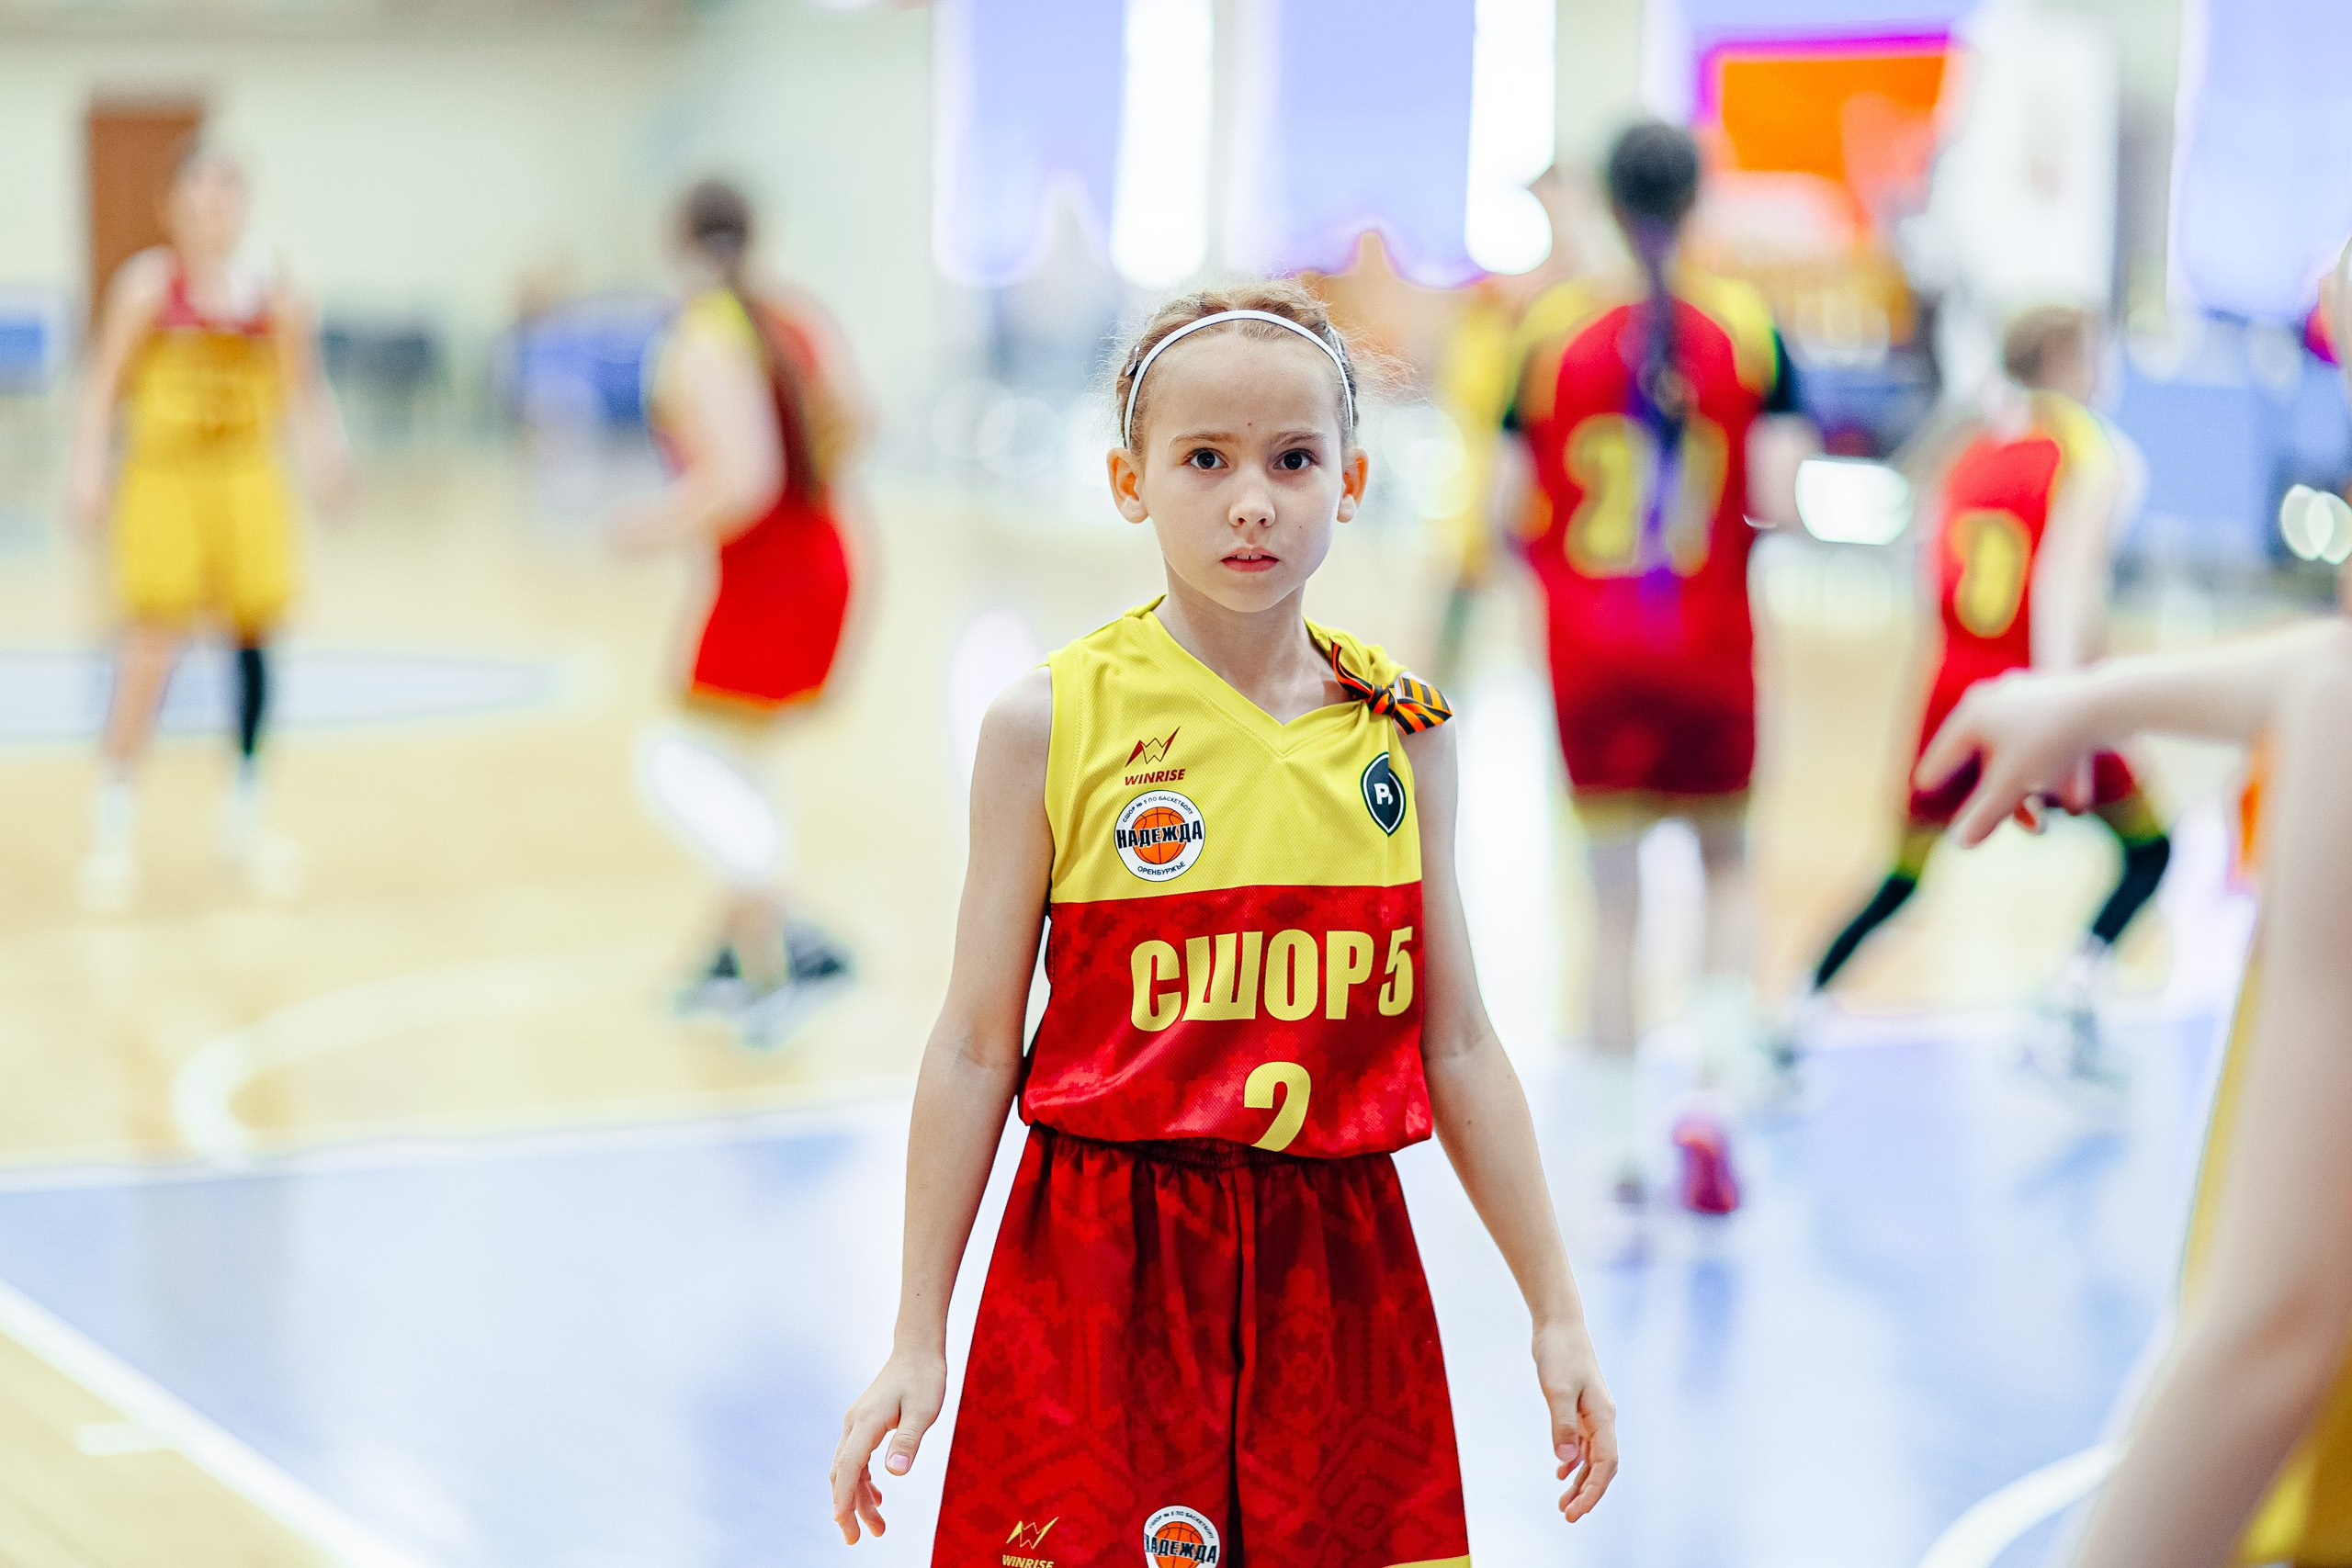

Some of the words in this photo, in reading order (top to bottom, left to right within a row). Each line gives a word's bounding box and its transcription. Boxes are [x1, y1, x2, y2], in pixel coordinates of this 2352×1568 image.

[1125, 768, 1186, 786] WINRISE
[1122, 806, 1136, 823] СШОР
[1159, 795, 1193, 815] БАСКЕТБОЛУ
[1115, 819, 1204, 850] НАДЕЖДА
[1136, 861, 1186, 876] ОРЕНБУРЖЬЕ
[1243, 1061, 1312, 1153] 2
[1002, 1554, 1055, 1568] WINRISE
